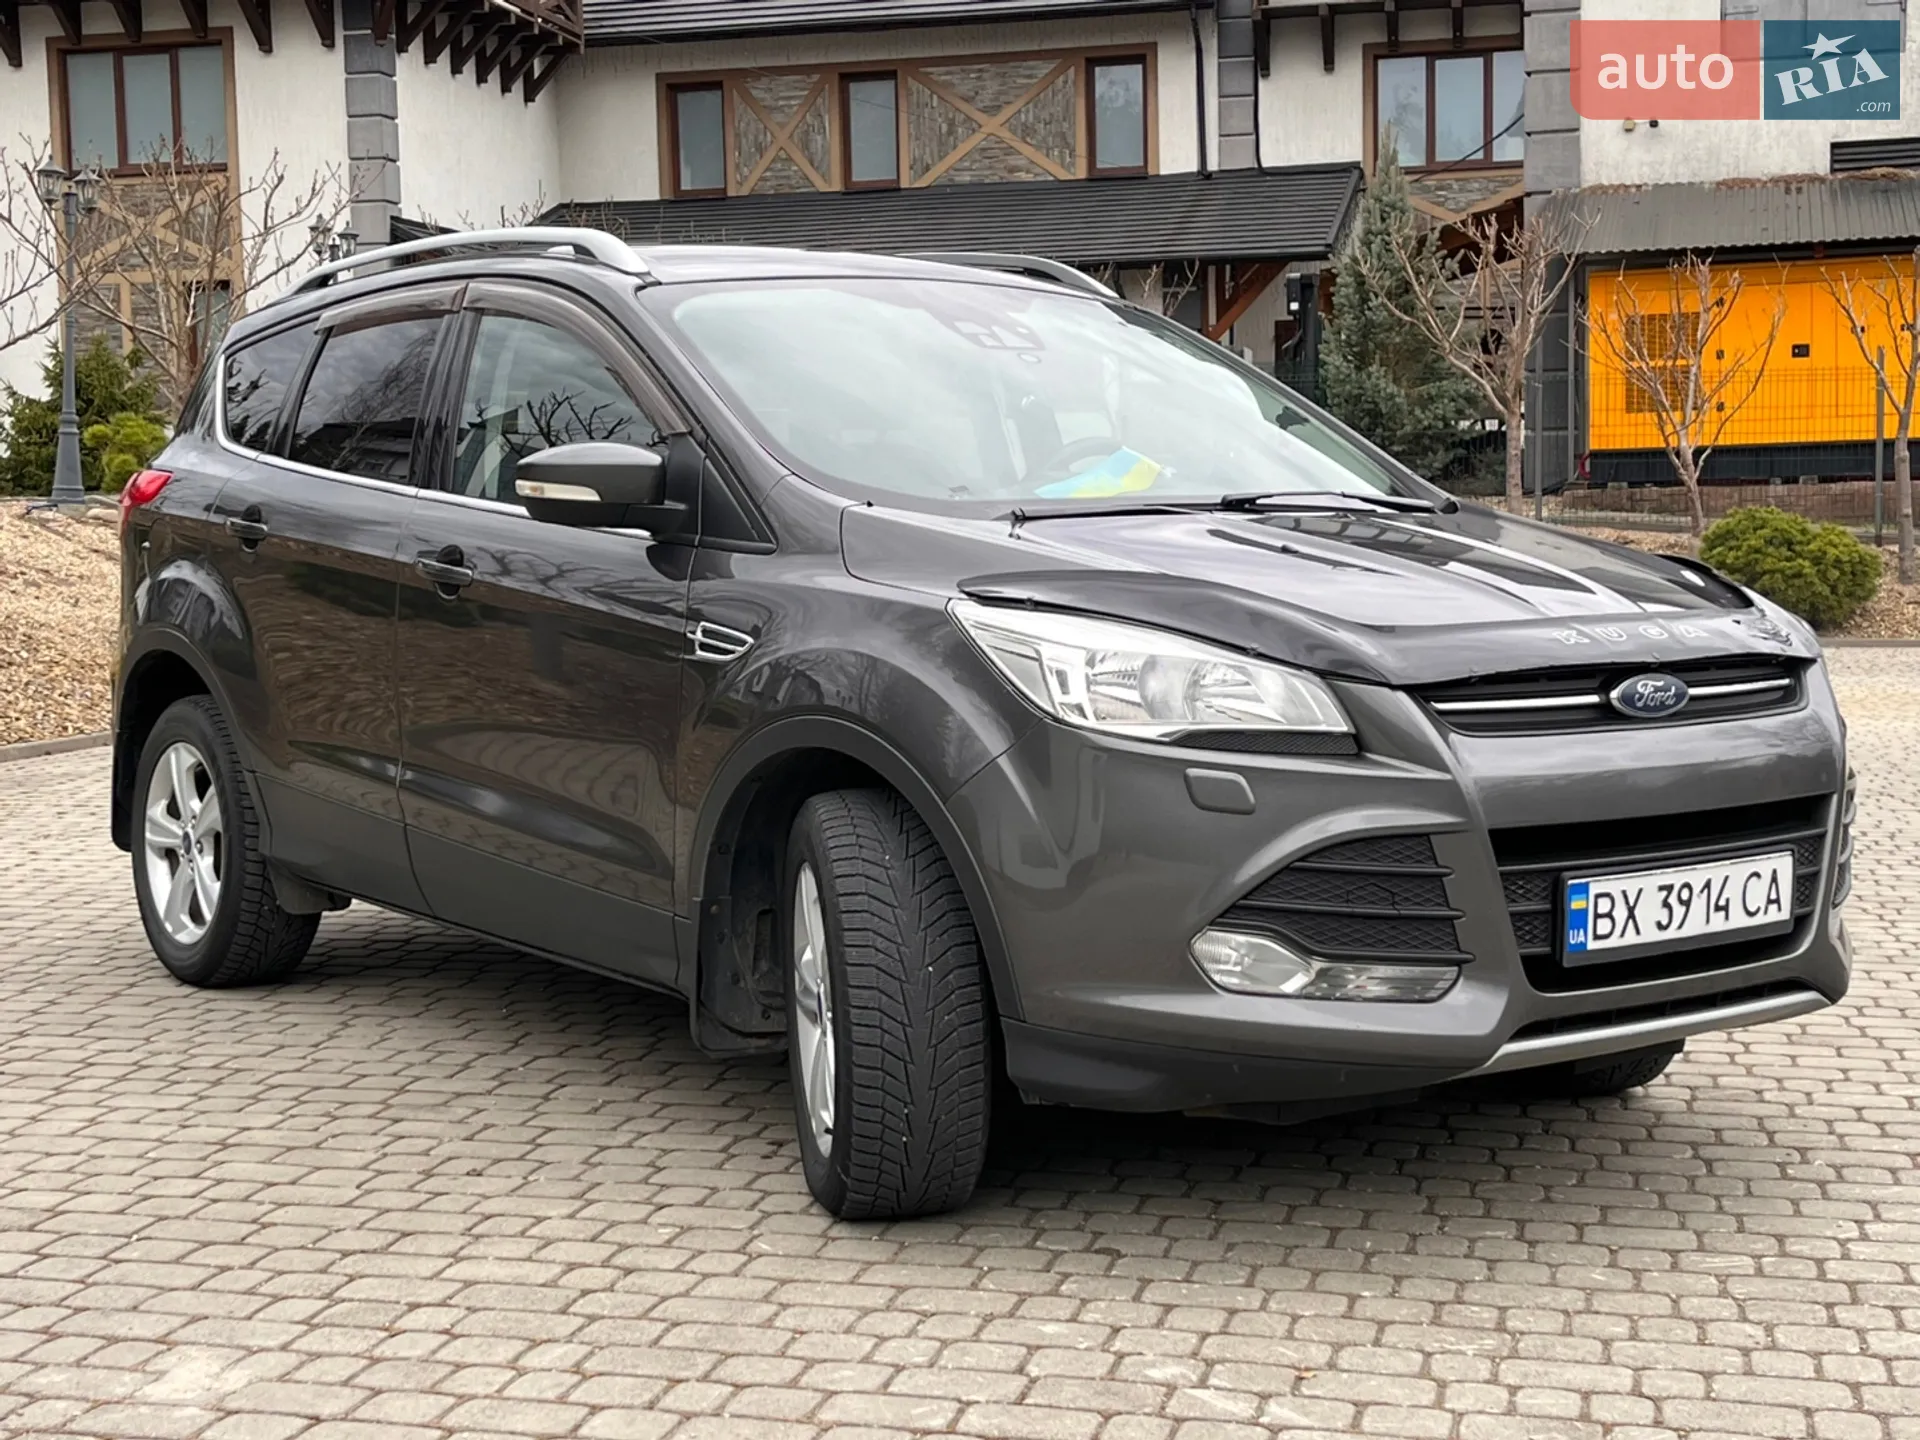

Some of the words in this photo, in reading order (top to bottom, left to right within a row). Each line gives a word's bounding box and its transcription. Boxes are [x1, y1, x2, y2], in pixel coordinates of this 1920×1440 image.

[1551, 624, 1710, 645] KUGA
[1634, 679, 1676, 707] Ford
[1592, 887, 1643, 941] BX
[1655, 875, 1730, 932] 3914
[1742, 868, 1782, 917] CA
[1569, 929, 1586, 944] UA
